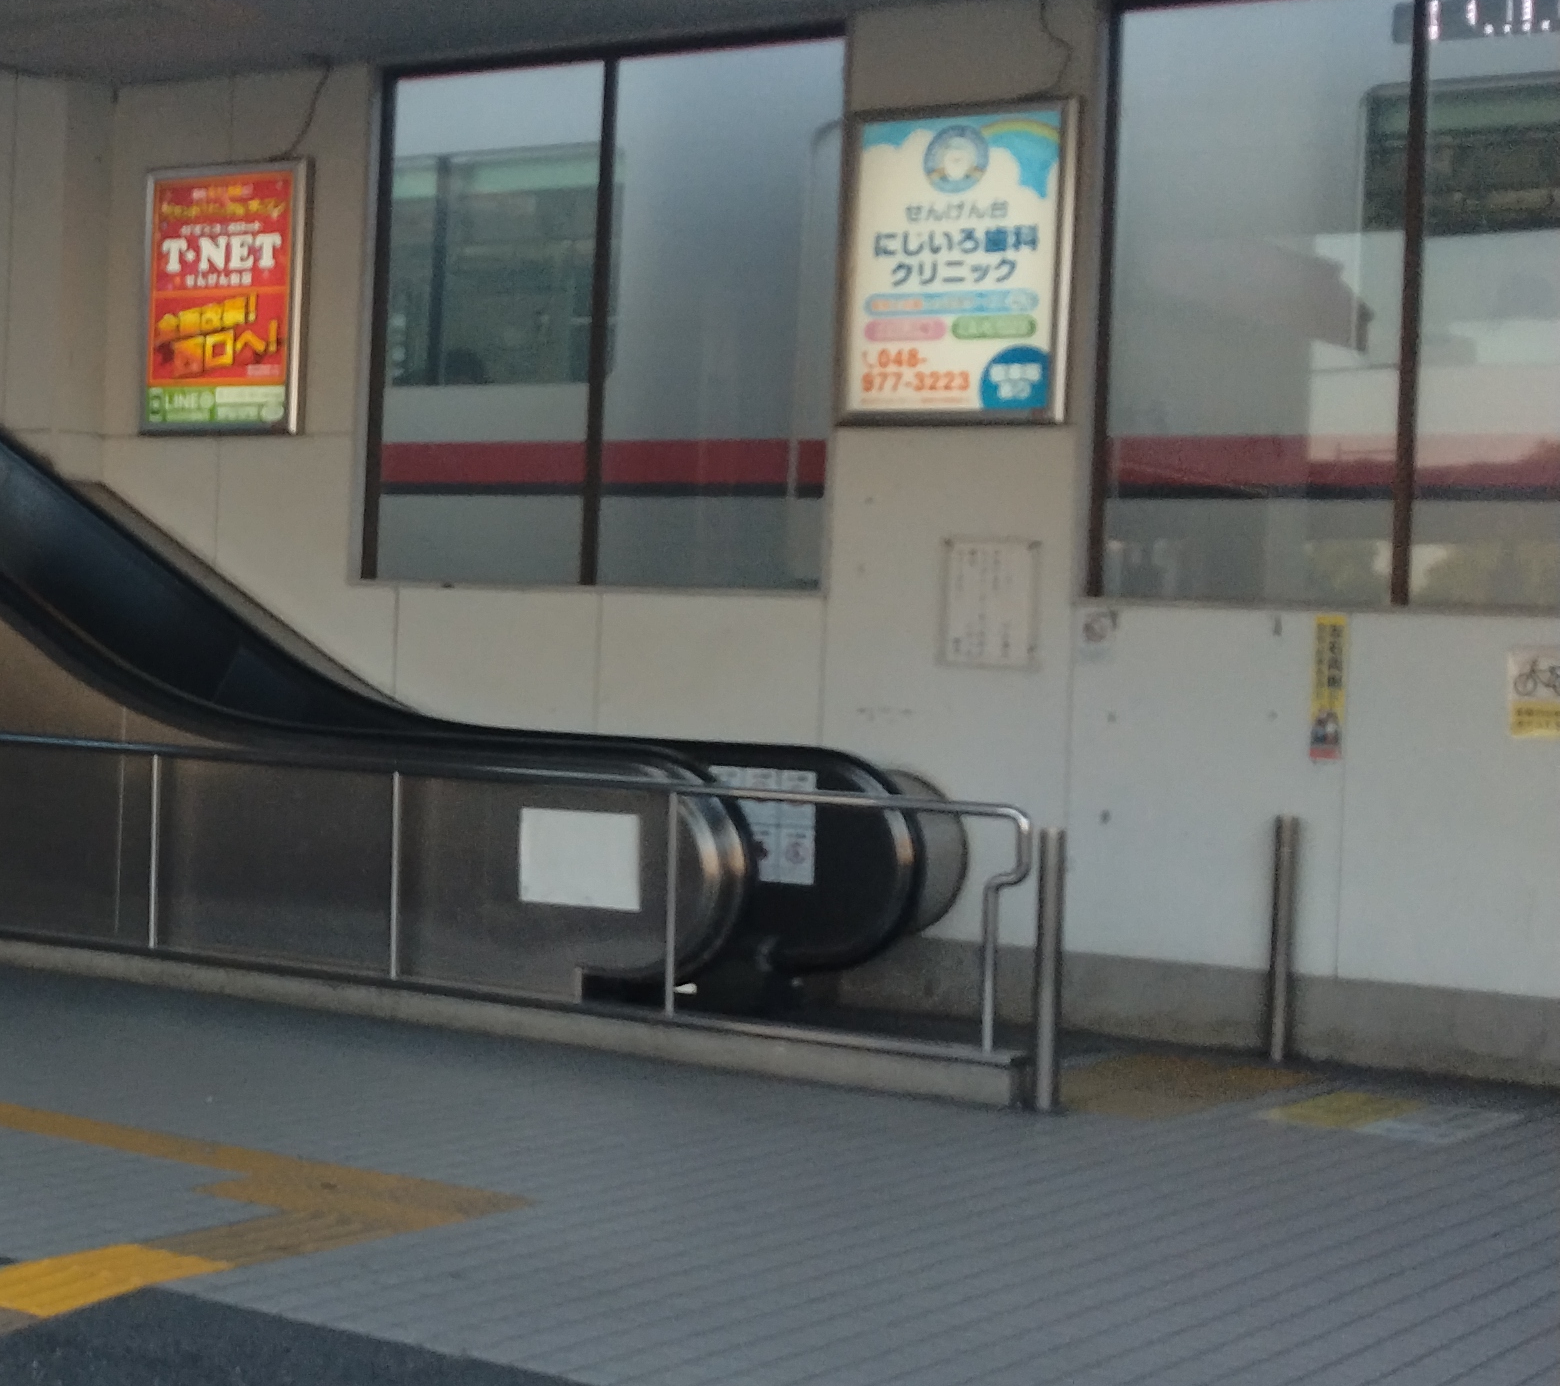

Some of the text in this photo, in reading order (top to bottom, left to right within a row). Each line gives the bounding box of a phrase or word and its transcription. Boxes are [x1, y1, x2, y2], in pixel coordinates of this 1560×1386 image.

[891, 258, 1018, 287] クリニック
